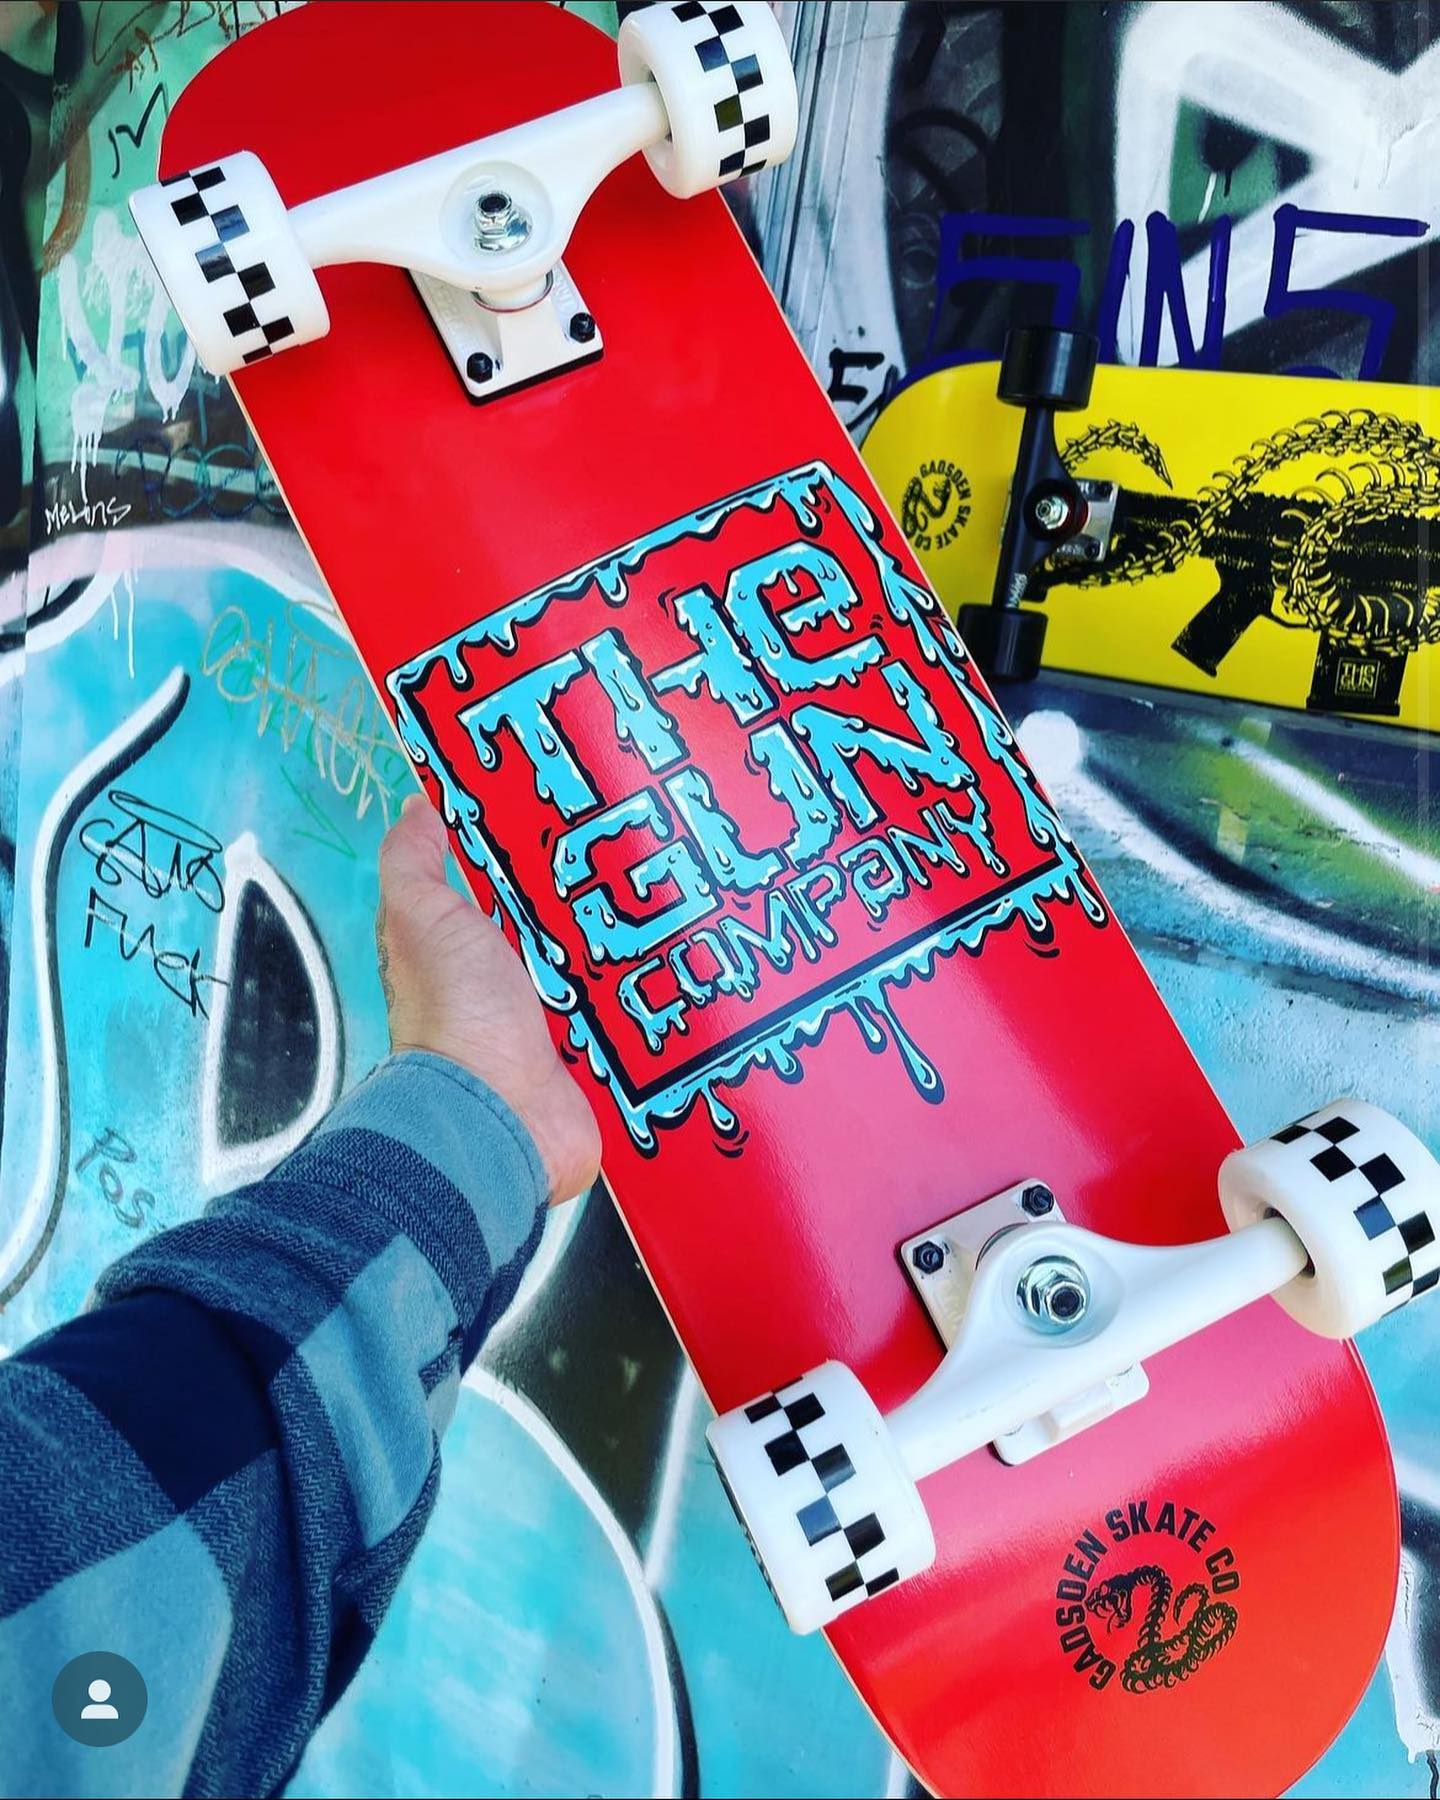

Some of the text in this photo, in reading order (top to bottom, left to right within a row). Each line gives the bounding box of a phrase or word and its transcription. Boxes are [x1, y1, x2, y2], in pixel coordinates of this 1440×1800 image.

[914, 533, 932, 551] CO
[935, 505, 972, 550] SKATE
[551, 660, 975, 963] GUN
[1055, 1500, 1240, 1691] GADSDEN SKATE CO
